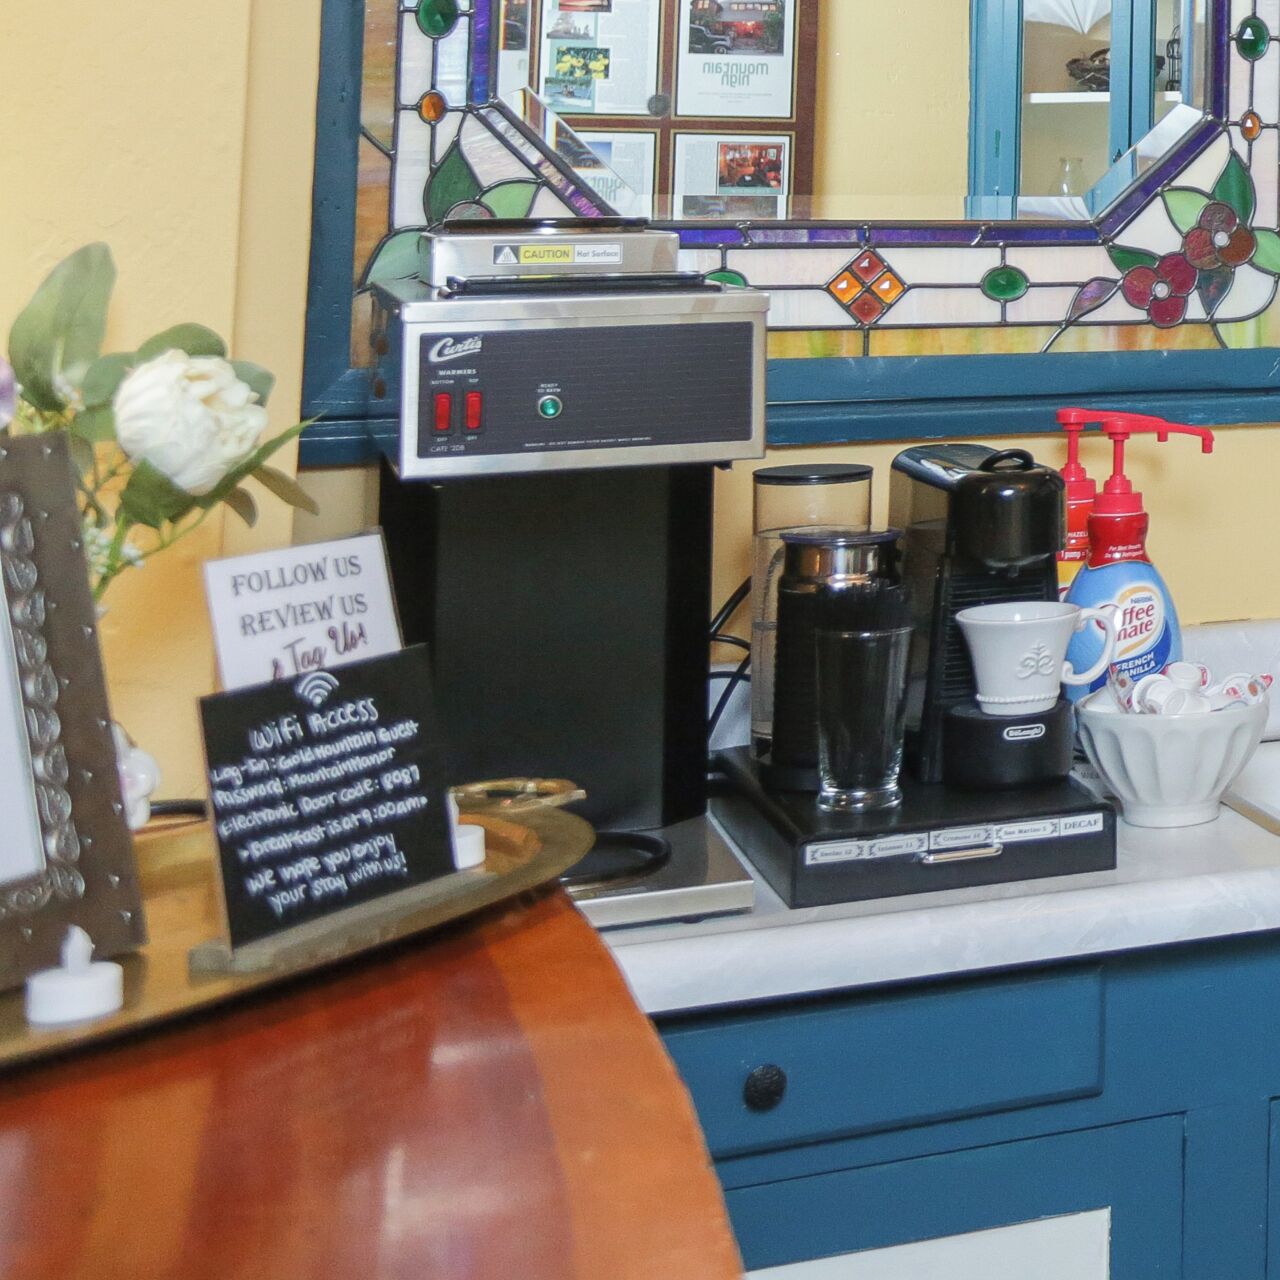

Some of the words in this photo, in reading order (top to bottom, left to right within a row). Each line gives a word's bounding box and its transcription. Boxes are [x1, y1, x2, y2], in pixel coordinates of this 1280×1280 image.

[523, 248, 571, 260] CAUTION
[577, 249, 590, 257] Hot
[591, 248, 620, 258] Surface
[428, 335, 483, 363] Curtis
[438, 369, 477, 377] WARMERS
[1065, 551, 1081, 560] pump
[231, 557, 329, 597] FOLLOW
[333, 555, 362, 578] US
[240, 595, 334, 637] REVIEW
[340, 593, 368, 616] US
[283, 637, 327, 673] Tag
[1117, 651, 1155, 670] FRENCH
[308, 698, 379, 734] Access
[378, 719, 419, 743] Guest
[219, 802, 299, 837] Electronic
[301, 791, 337, 814] Door
[382, 765, 420, 791] 8087
[250, 826, 326, 860] Breakfast
[327, 820, 341, 836] is
[1064, 818, 1100, 830] DECAF
[323, 849, 351, 872] you
[352, 833, 397, 858] enjoy
[267, 883, 308, 917] your
[312, 874, 348, 897] stay
[351, 860, 383, 883] with
